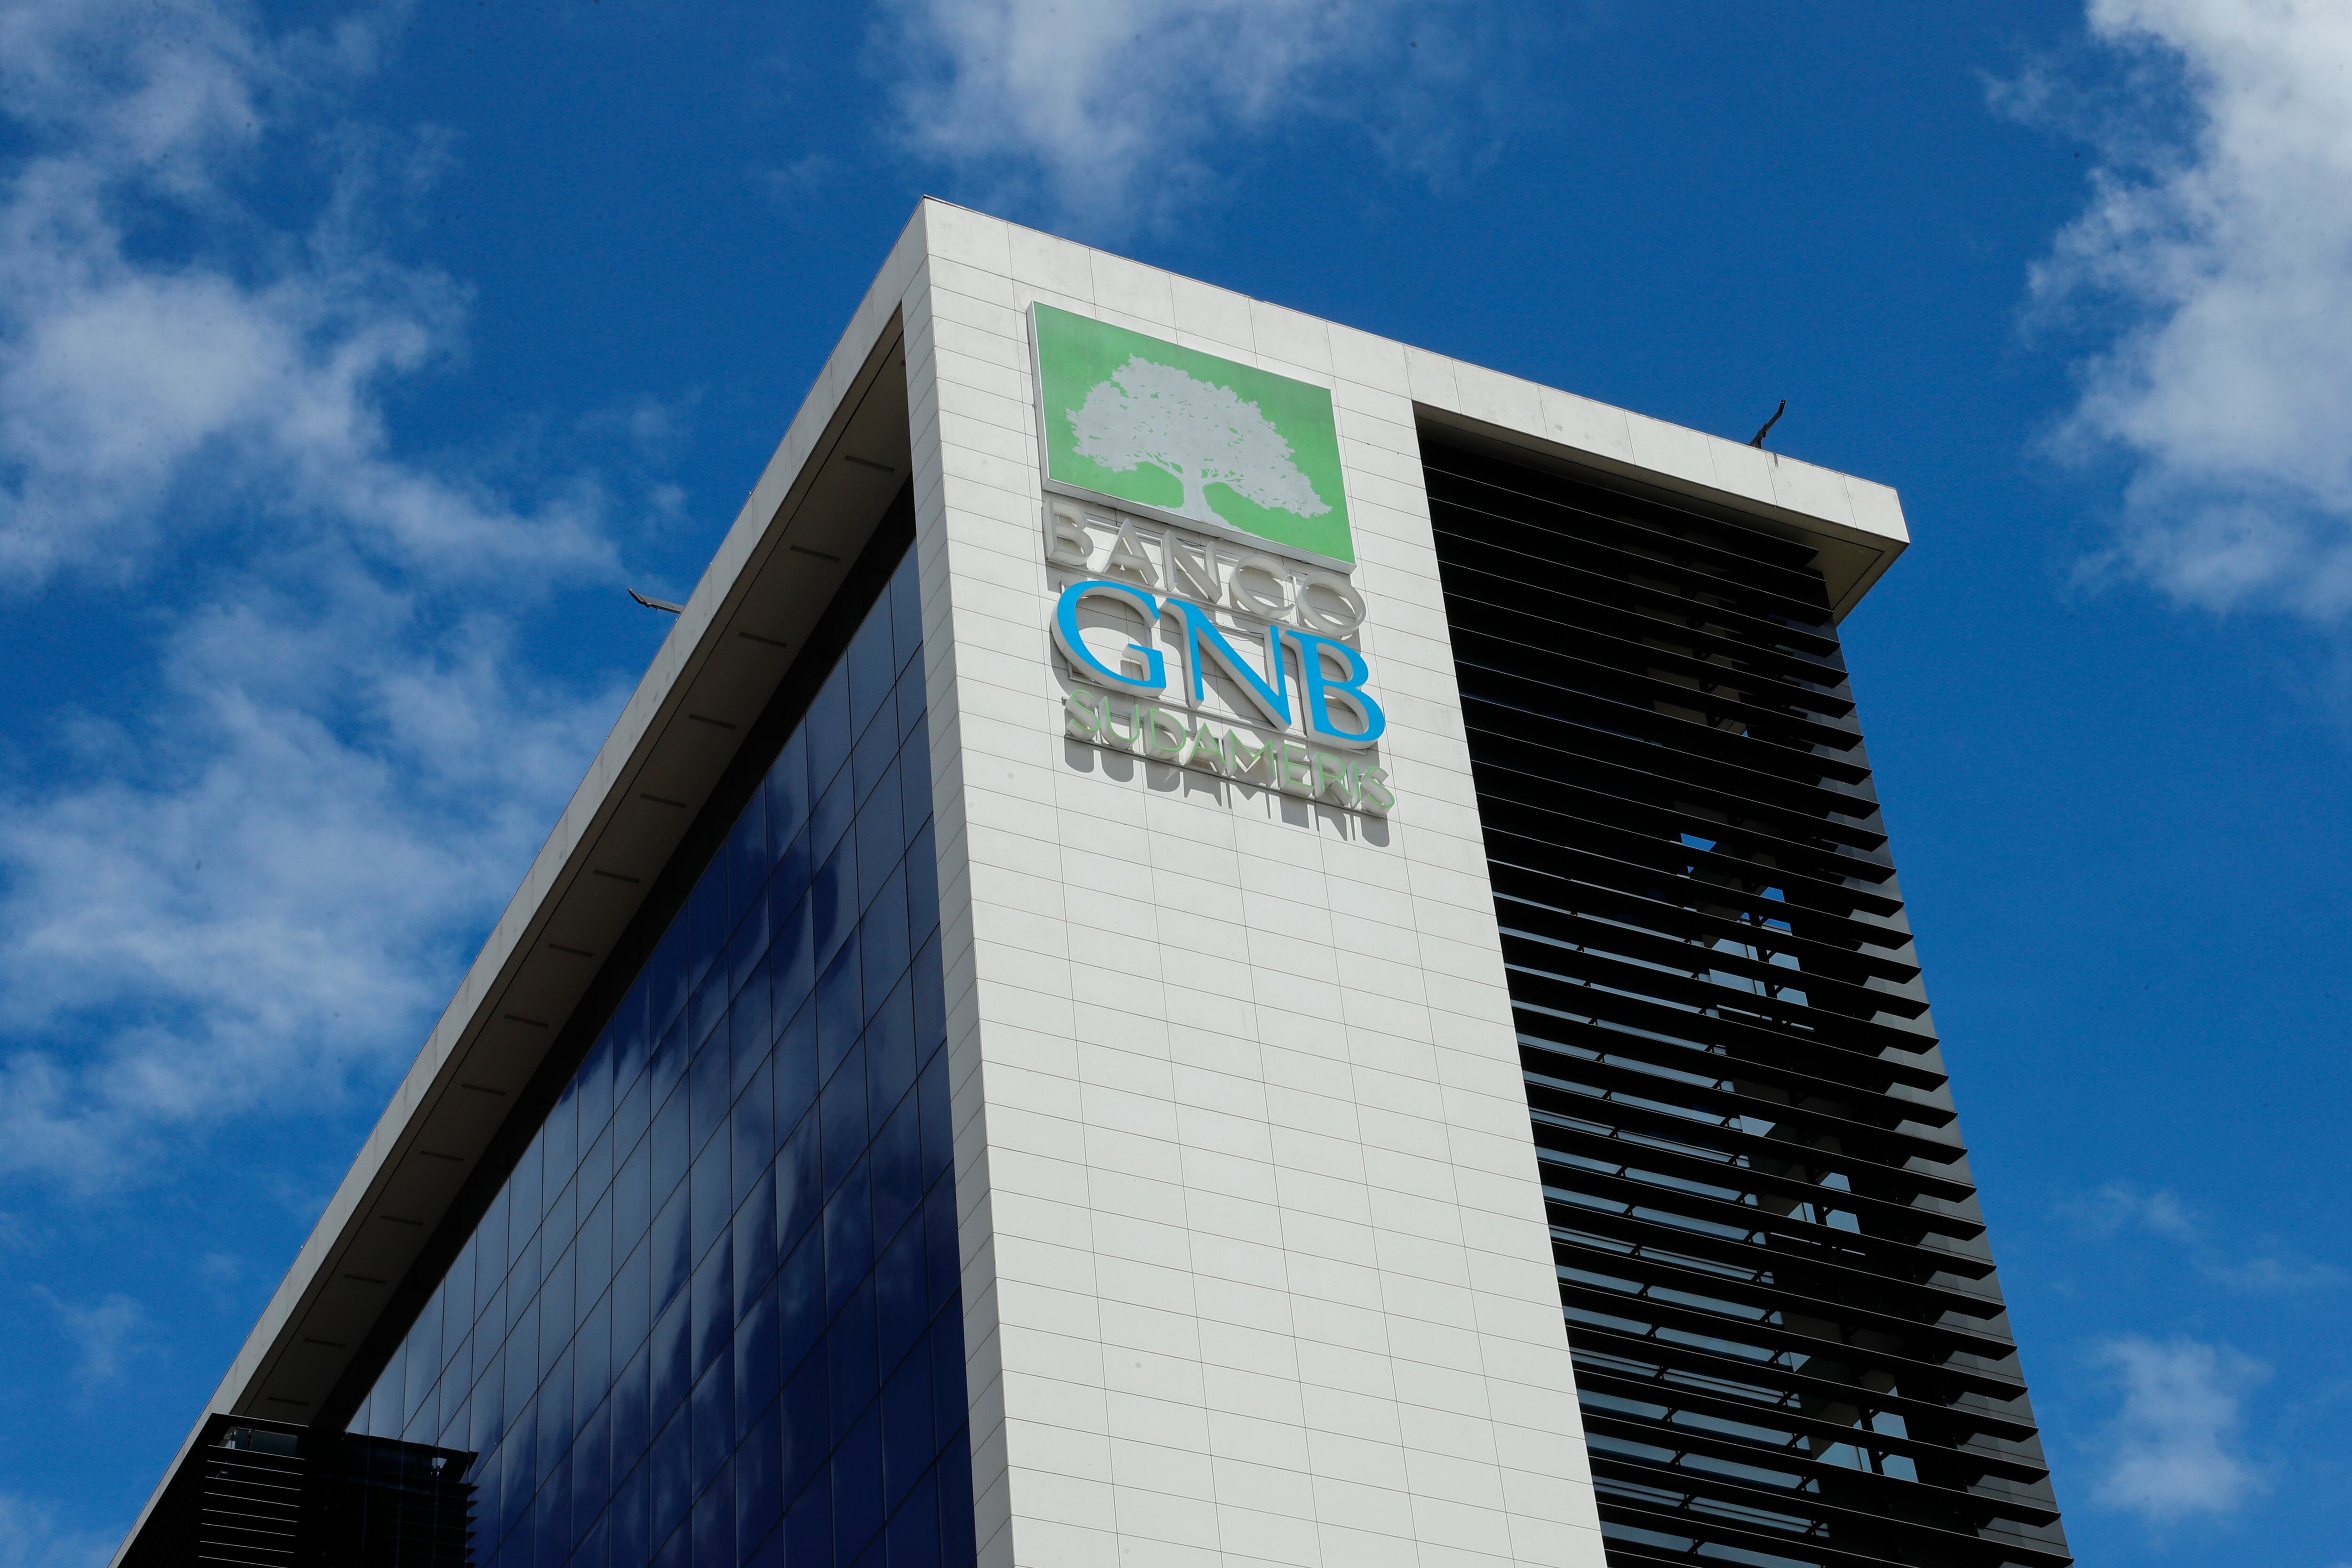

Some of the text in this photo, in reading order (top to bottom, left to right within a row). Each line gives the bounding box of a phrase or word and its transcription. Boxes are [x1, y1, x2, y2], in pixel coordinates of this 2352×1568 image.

[1046, 498, 1367, 637] BANCO
[1052, 580, 1386, 746] GNB
[1065, 689, 1396, 814] SUDAMERIS
